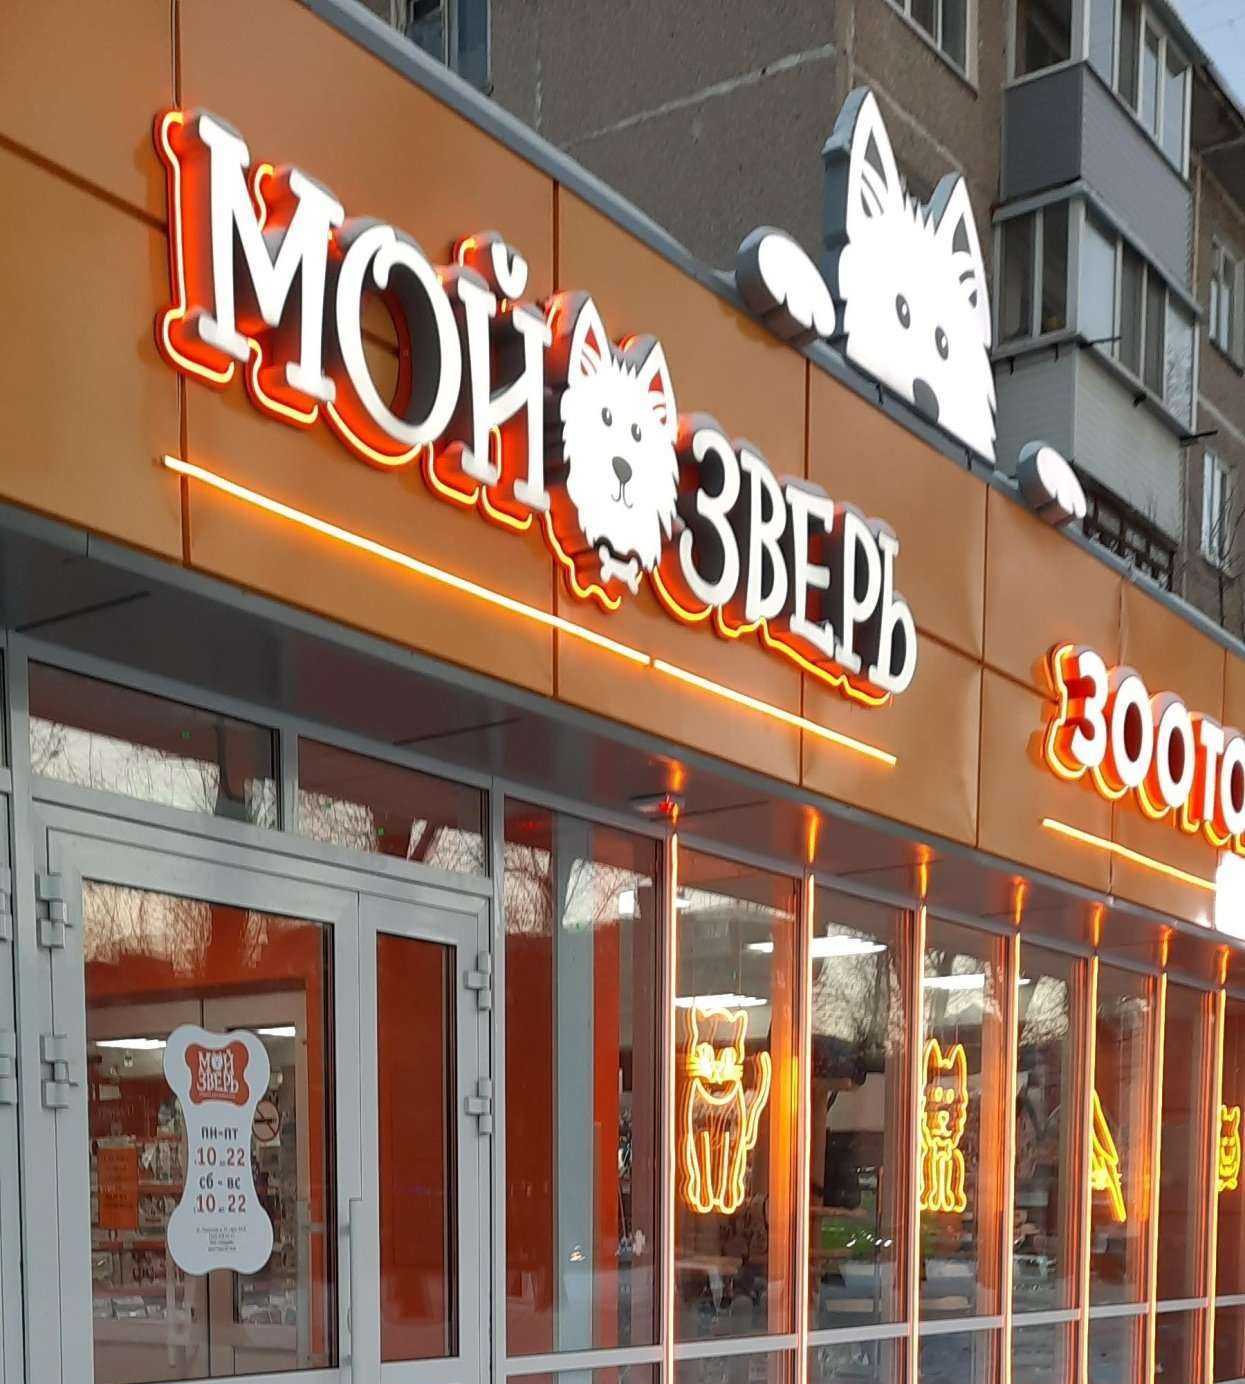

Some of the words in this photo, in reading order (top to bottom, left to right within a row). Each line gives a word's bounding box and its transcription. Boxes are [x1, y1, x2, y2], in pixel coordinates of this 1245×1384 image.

[199, 114, 551, 512] МОЙ
[679, 428, 917, 695] ЗВЕРЬ
[196, 1071, 239, 1093] ЗВЕРЬ
[197, 1146, 217, 1166] 10
[226, 1147, 245, 1167] 22
[196, 1194, 216, 1213] 10
[228, 1194, 246, 1213] 22
